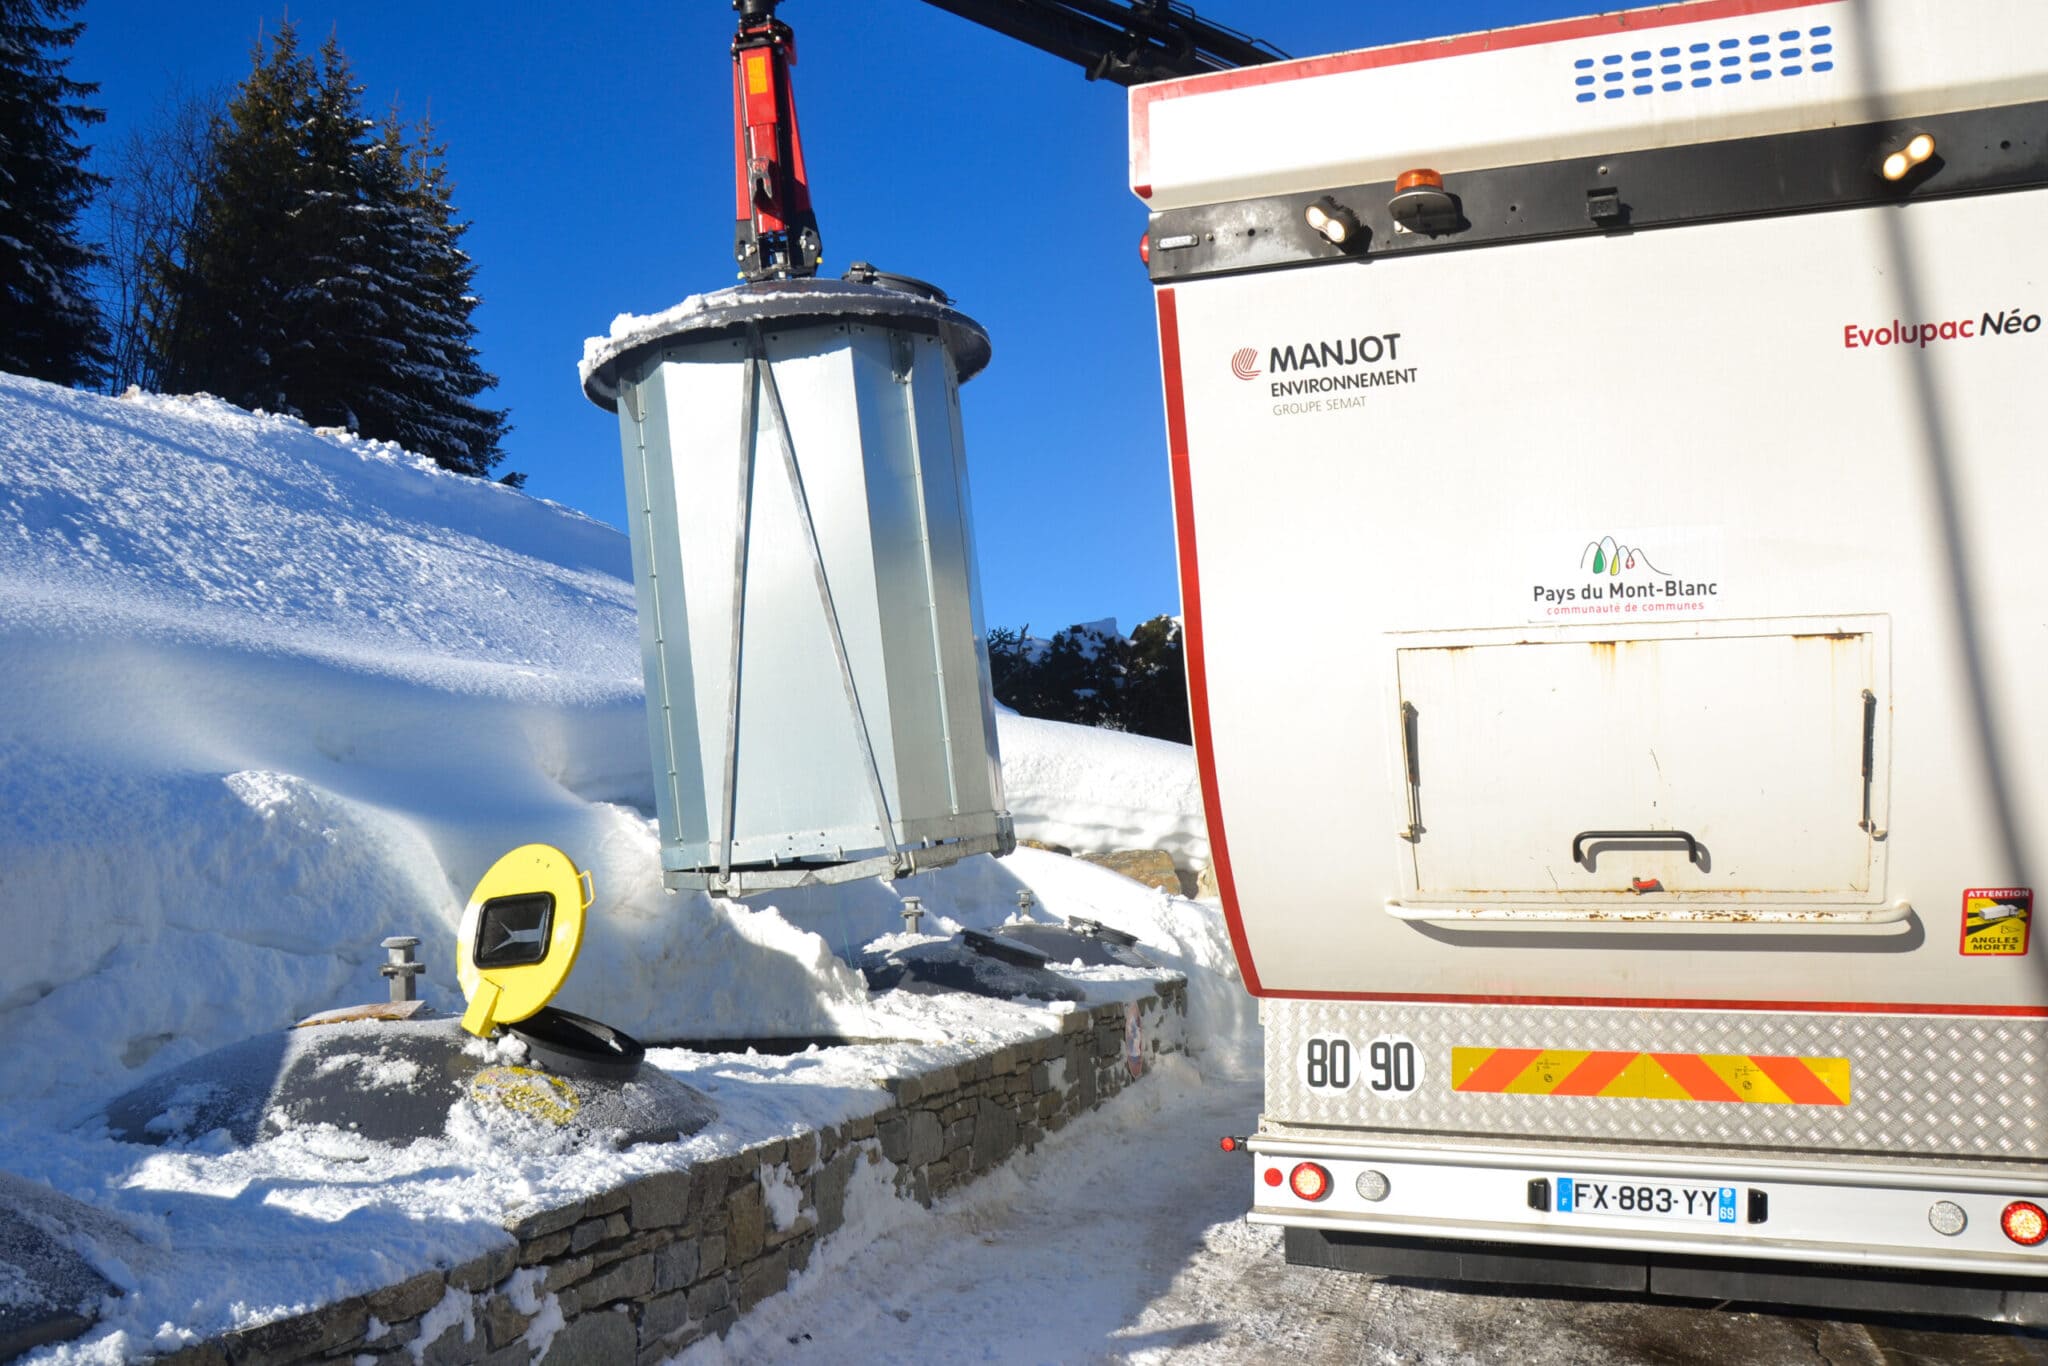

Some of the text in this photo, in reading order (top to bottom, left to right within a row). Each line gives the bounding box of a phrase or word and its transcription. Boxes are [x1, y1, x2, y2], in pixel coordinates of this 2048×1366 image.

[1844, 308, 2041, 349] Evolupac Néo
[1269, 333, 1401, 374] MANJOT
[1271, 367, 1418, 397] ENVIRONNEMENT
[1272, 395, 1367, 416] GROUPE SEMAT
[1533, 580, 1718, 605] Pays du Mont-Blanc
[1547, 601, 1705, 616] communauté de communes
[1307, 1038, 1350, 1089] 80
[1370, 1041, 1415, 1092] 90
[1574, 1182, 1718, 1216] FX-883-YY
[1720, 1207, 1734, 1219] 69
